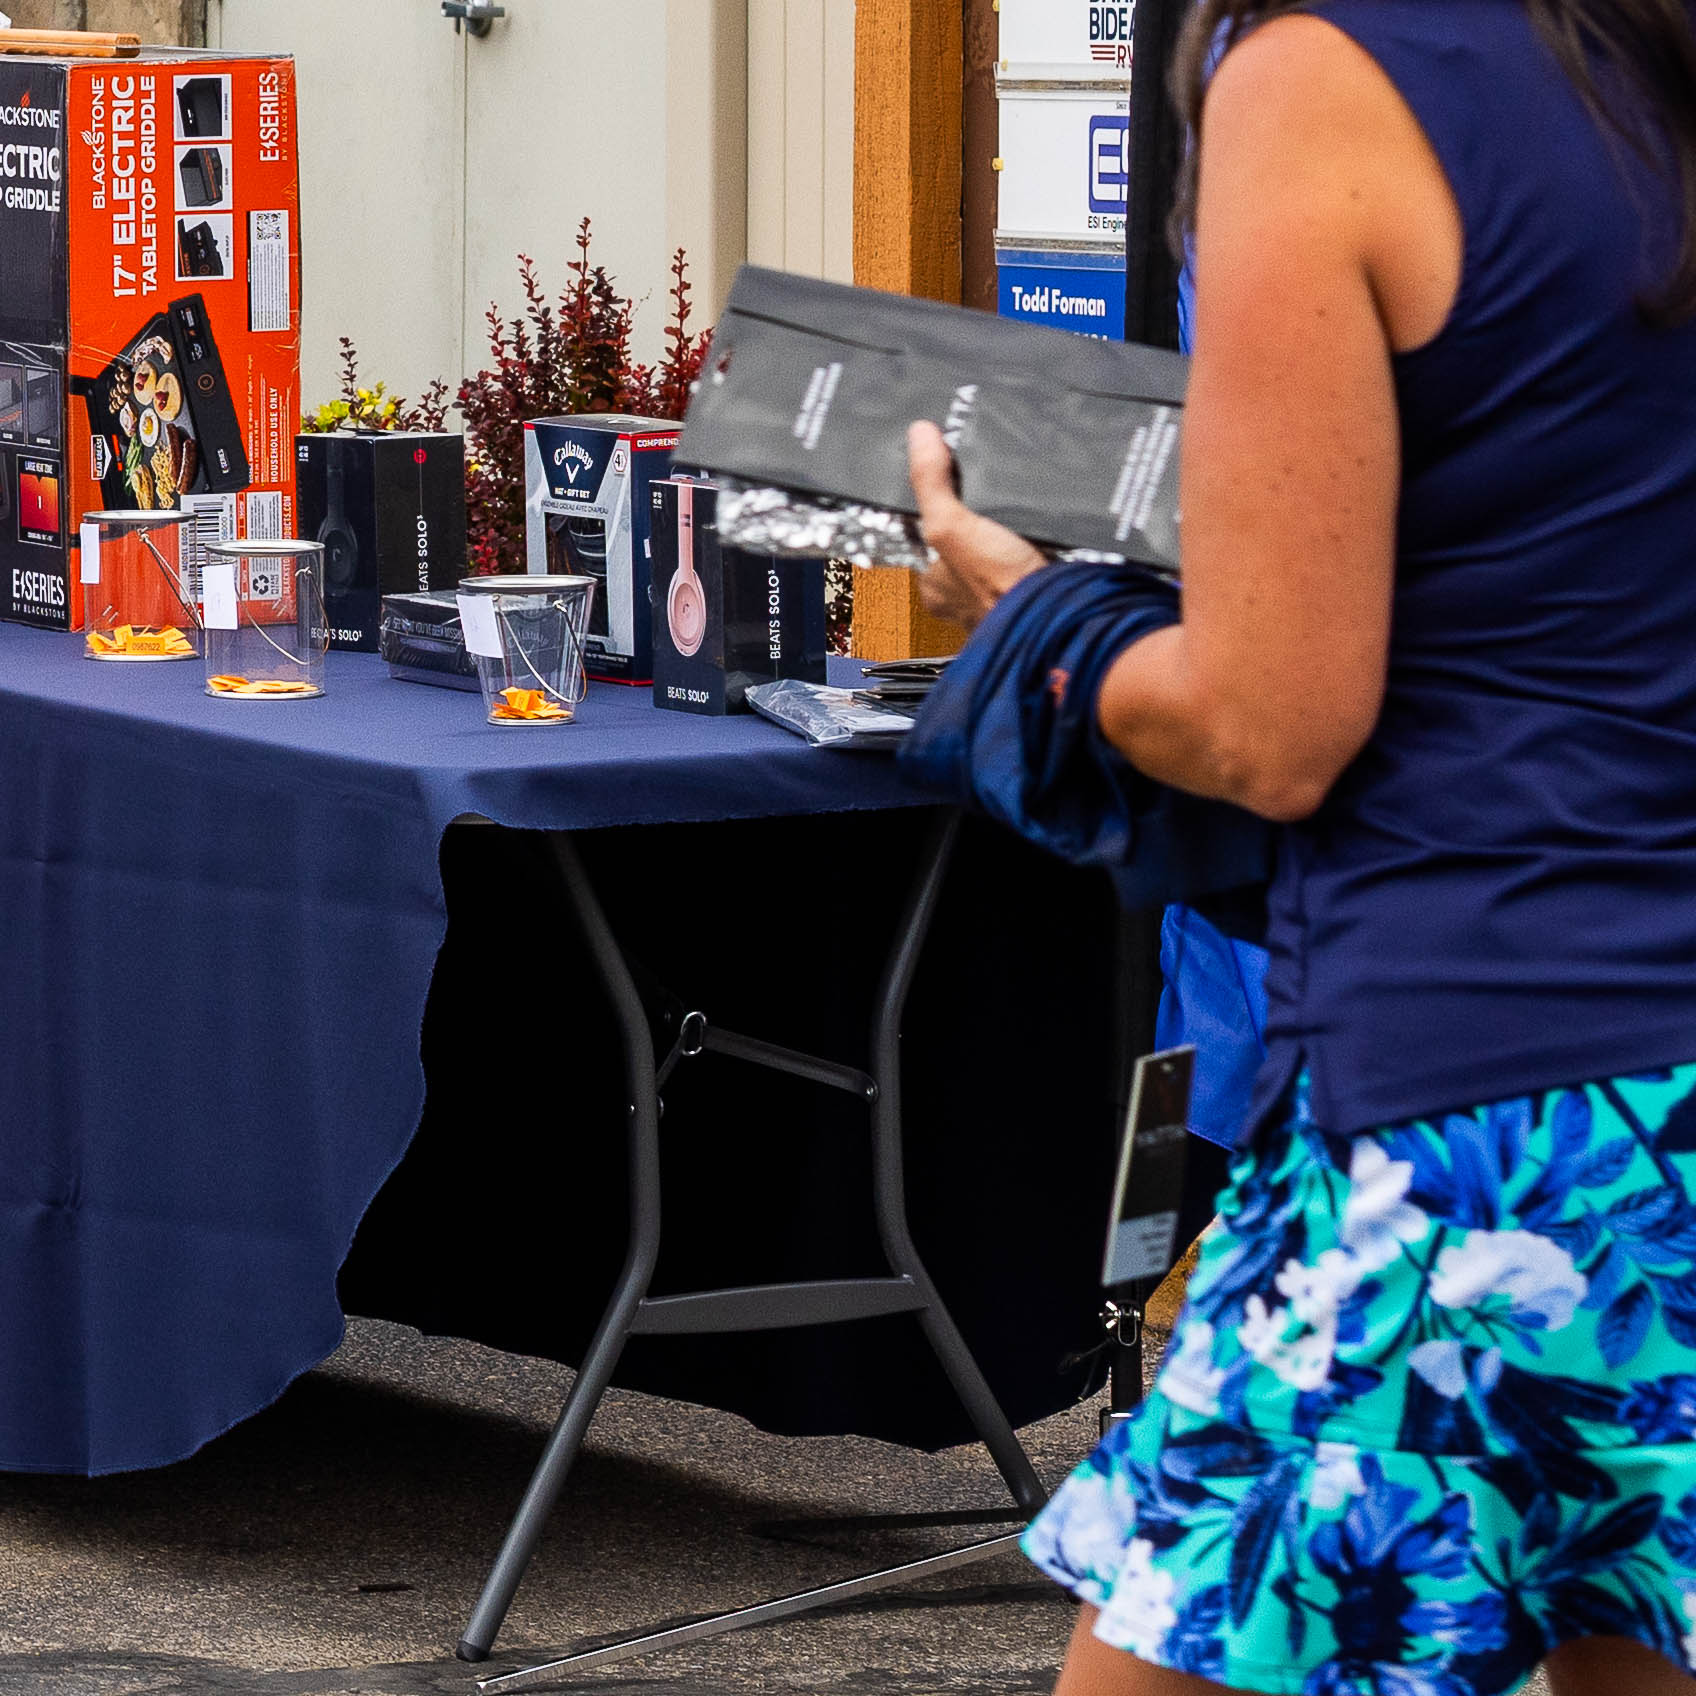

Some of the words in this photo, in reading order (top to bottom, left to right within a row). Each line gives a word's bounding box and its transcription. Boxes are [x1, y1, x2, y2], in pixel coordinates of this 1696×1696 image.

[140, 75, 156, 173] GRIDDLE
[92, 76, 106, 209] BLACKSTONE
[111, 75, 136, 245] ELECTRIC
[5, 186, 61, 212] GRIDDLE
[141, 177, 157, 296] TABLETOP
[1102, 216, 1126, 232] Engin
[1011, 286, 1049, 313] Todd
[1051, 288, 1106, 317] Forman
[269, 387, 278, 409] ONLY
[269, 411, 278, 429] USE
[270, 431, 279, 483] HOUSEHOLD
[554, 440, 594, 471] Callaway
[418, 561, 429, 592] EATS
[770, 619, 781, 659] BEATS
[667, 686, 687, 701] BEATS
